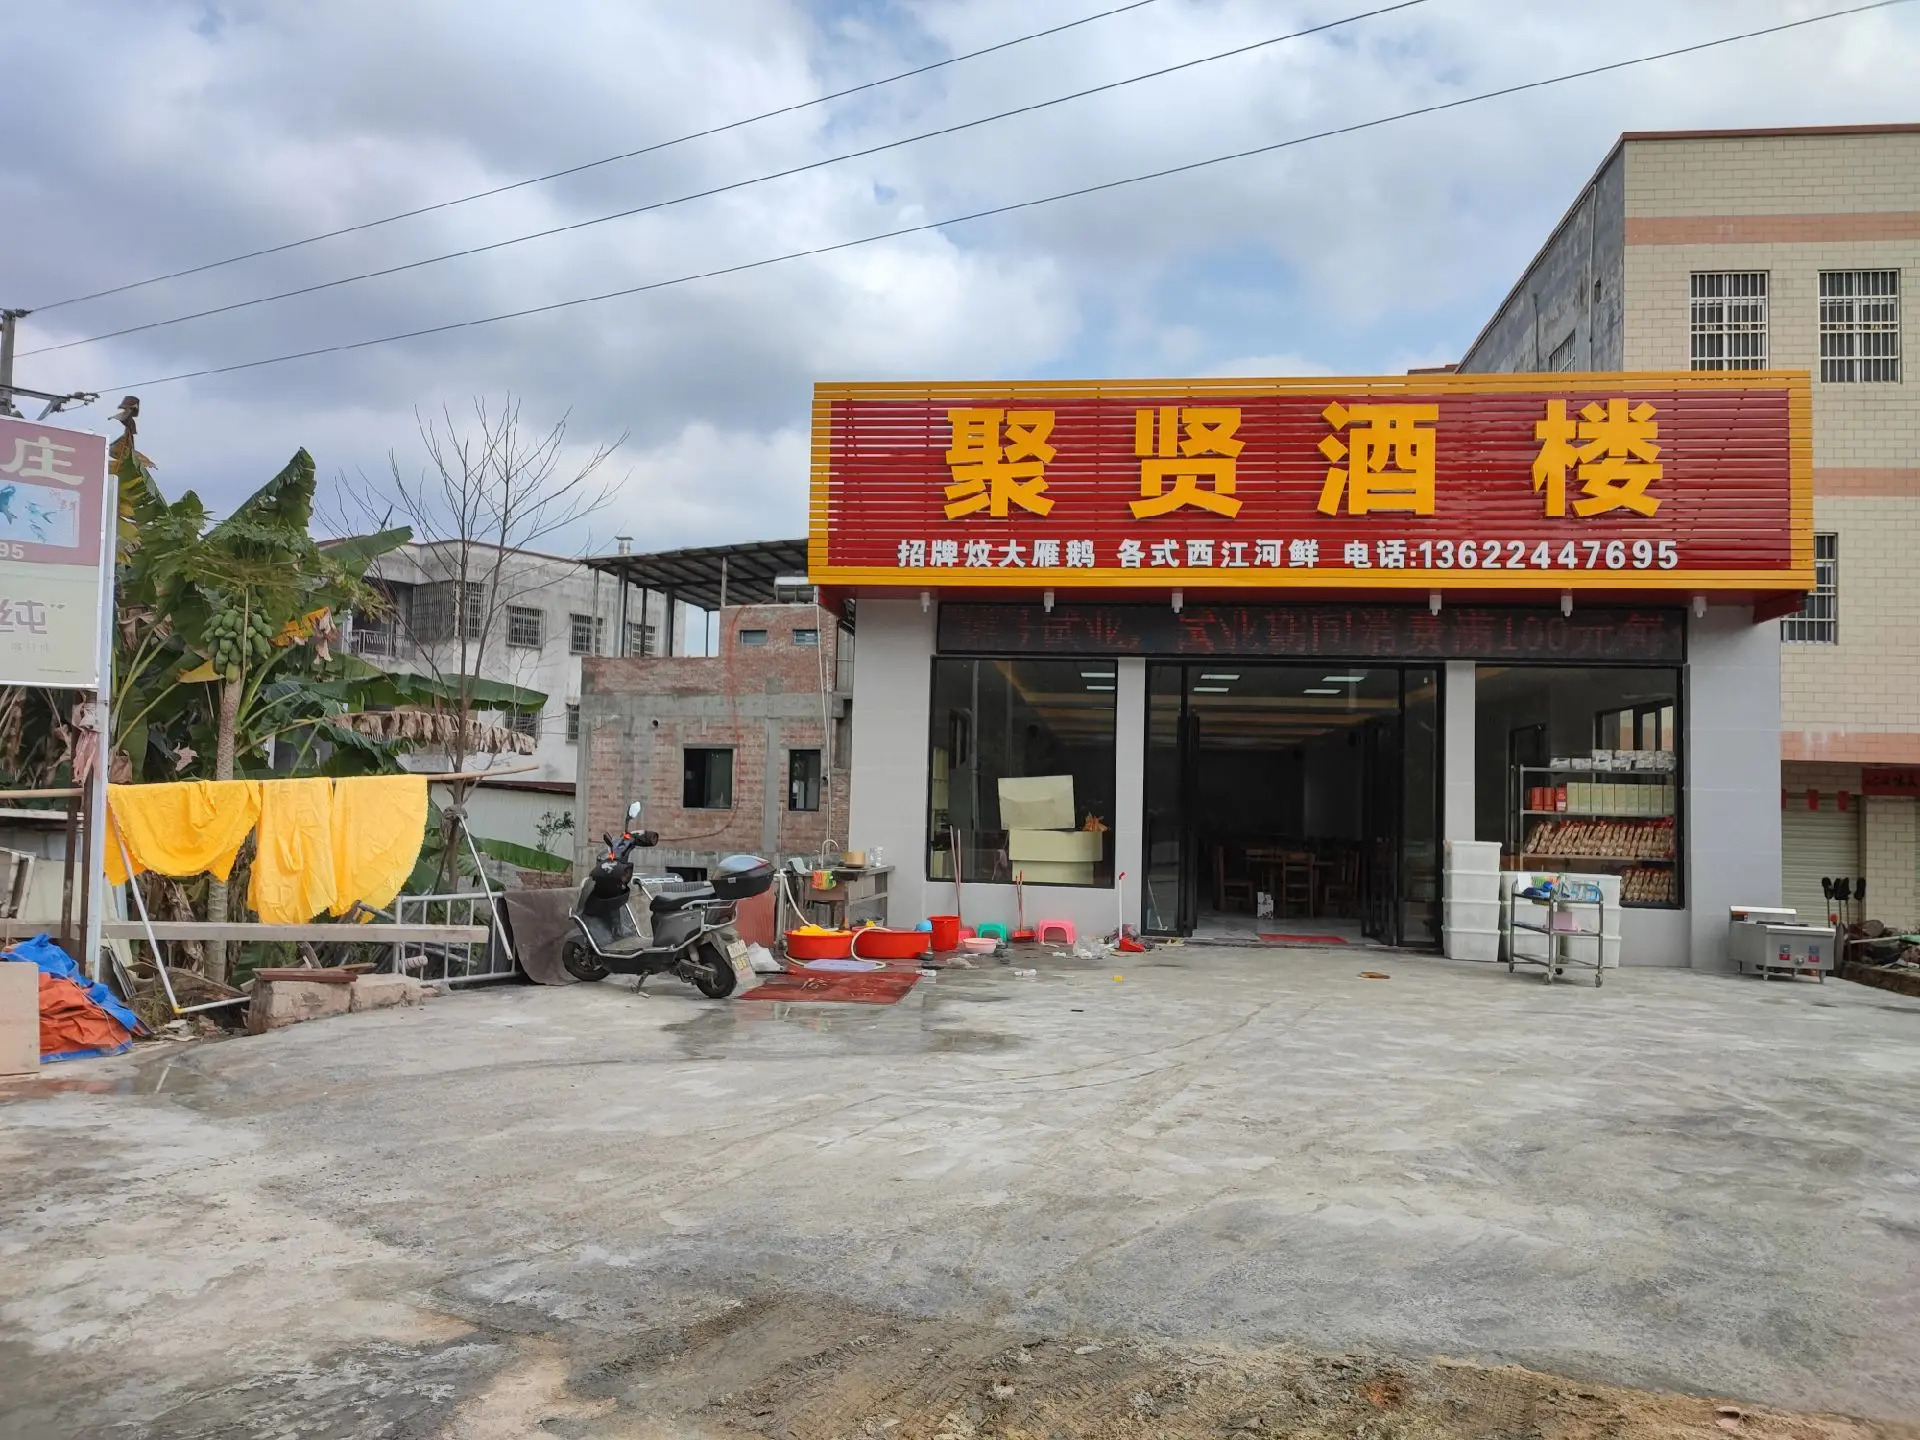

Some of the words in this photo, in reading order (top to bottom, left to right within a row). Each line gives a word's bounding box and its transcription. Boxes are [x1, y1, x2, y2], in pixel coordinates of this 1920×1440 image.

[944, 398, 1664, 520] 聚贤酒楼
[897, 539, 1096, 568] 招牌炆大雁鹅
[1116, 538, 1320, 568] 各式西江河鲜
[1344, 540, 1679, 569] 电话:13622447695
